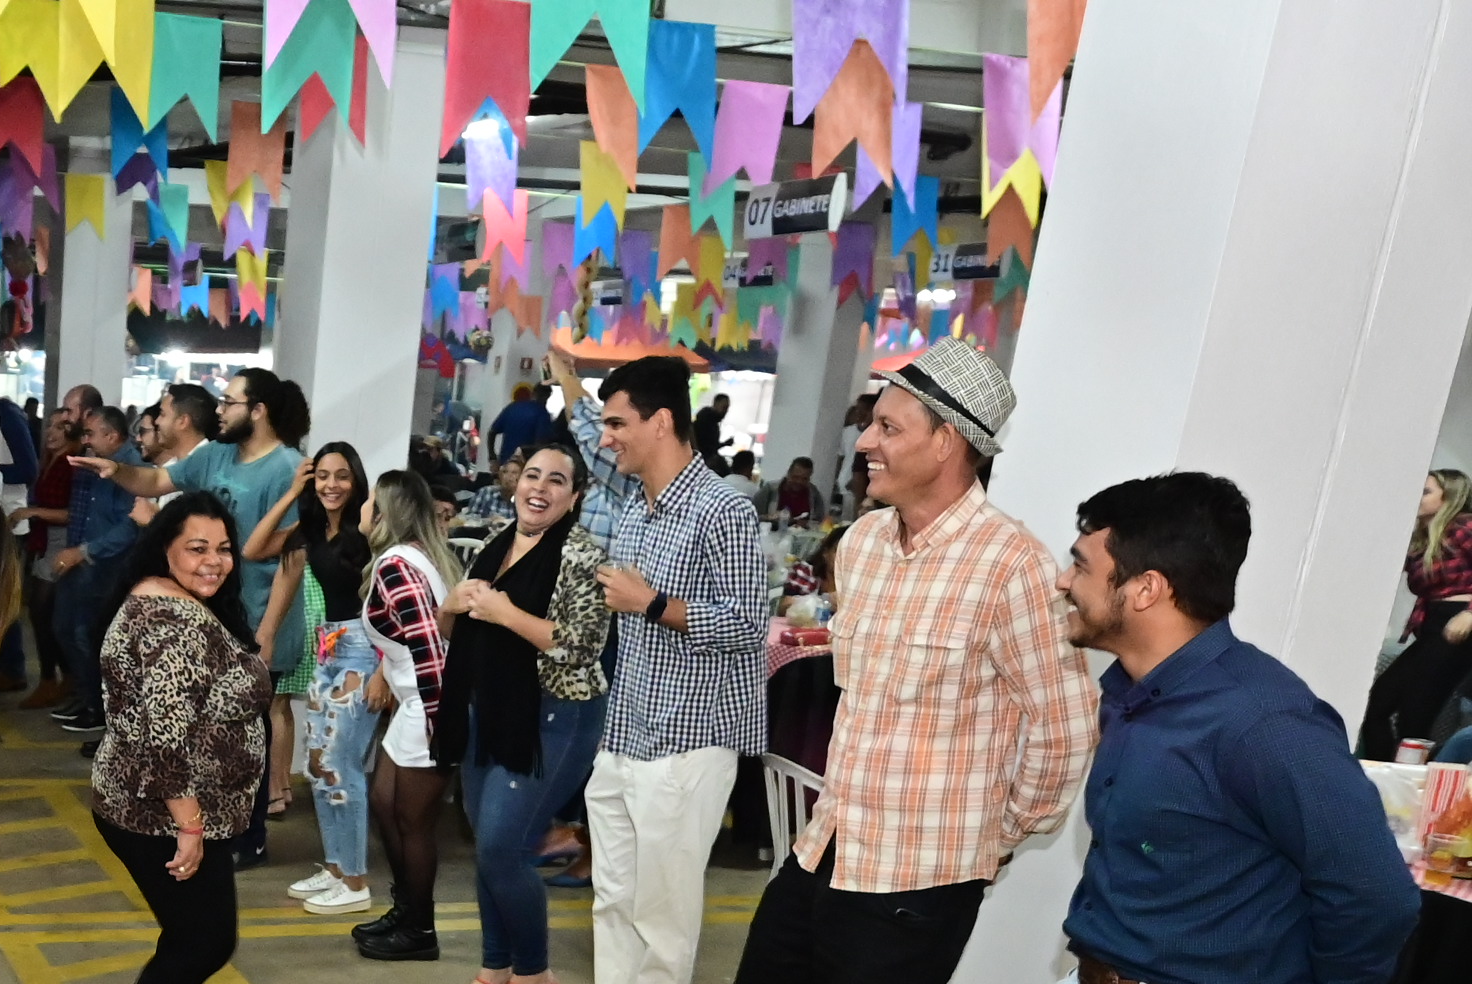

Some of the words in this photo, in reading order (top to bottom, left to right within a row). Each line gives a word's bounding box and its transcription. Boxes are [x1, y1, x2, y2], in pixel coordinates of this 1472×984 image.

[748, 196, 772, 226] 07
[773, 194, 831, 218] GABINETE
[932, 253, 950, 273] 31
